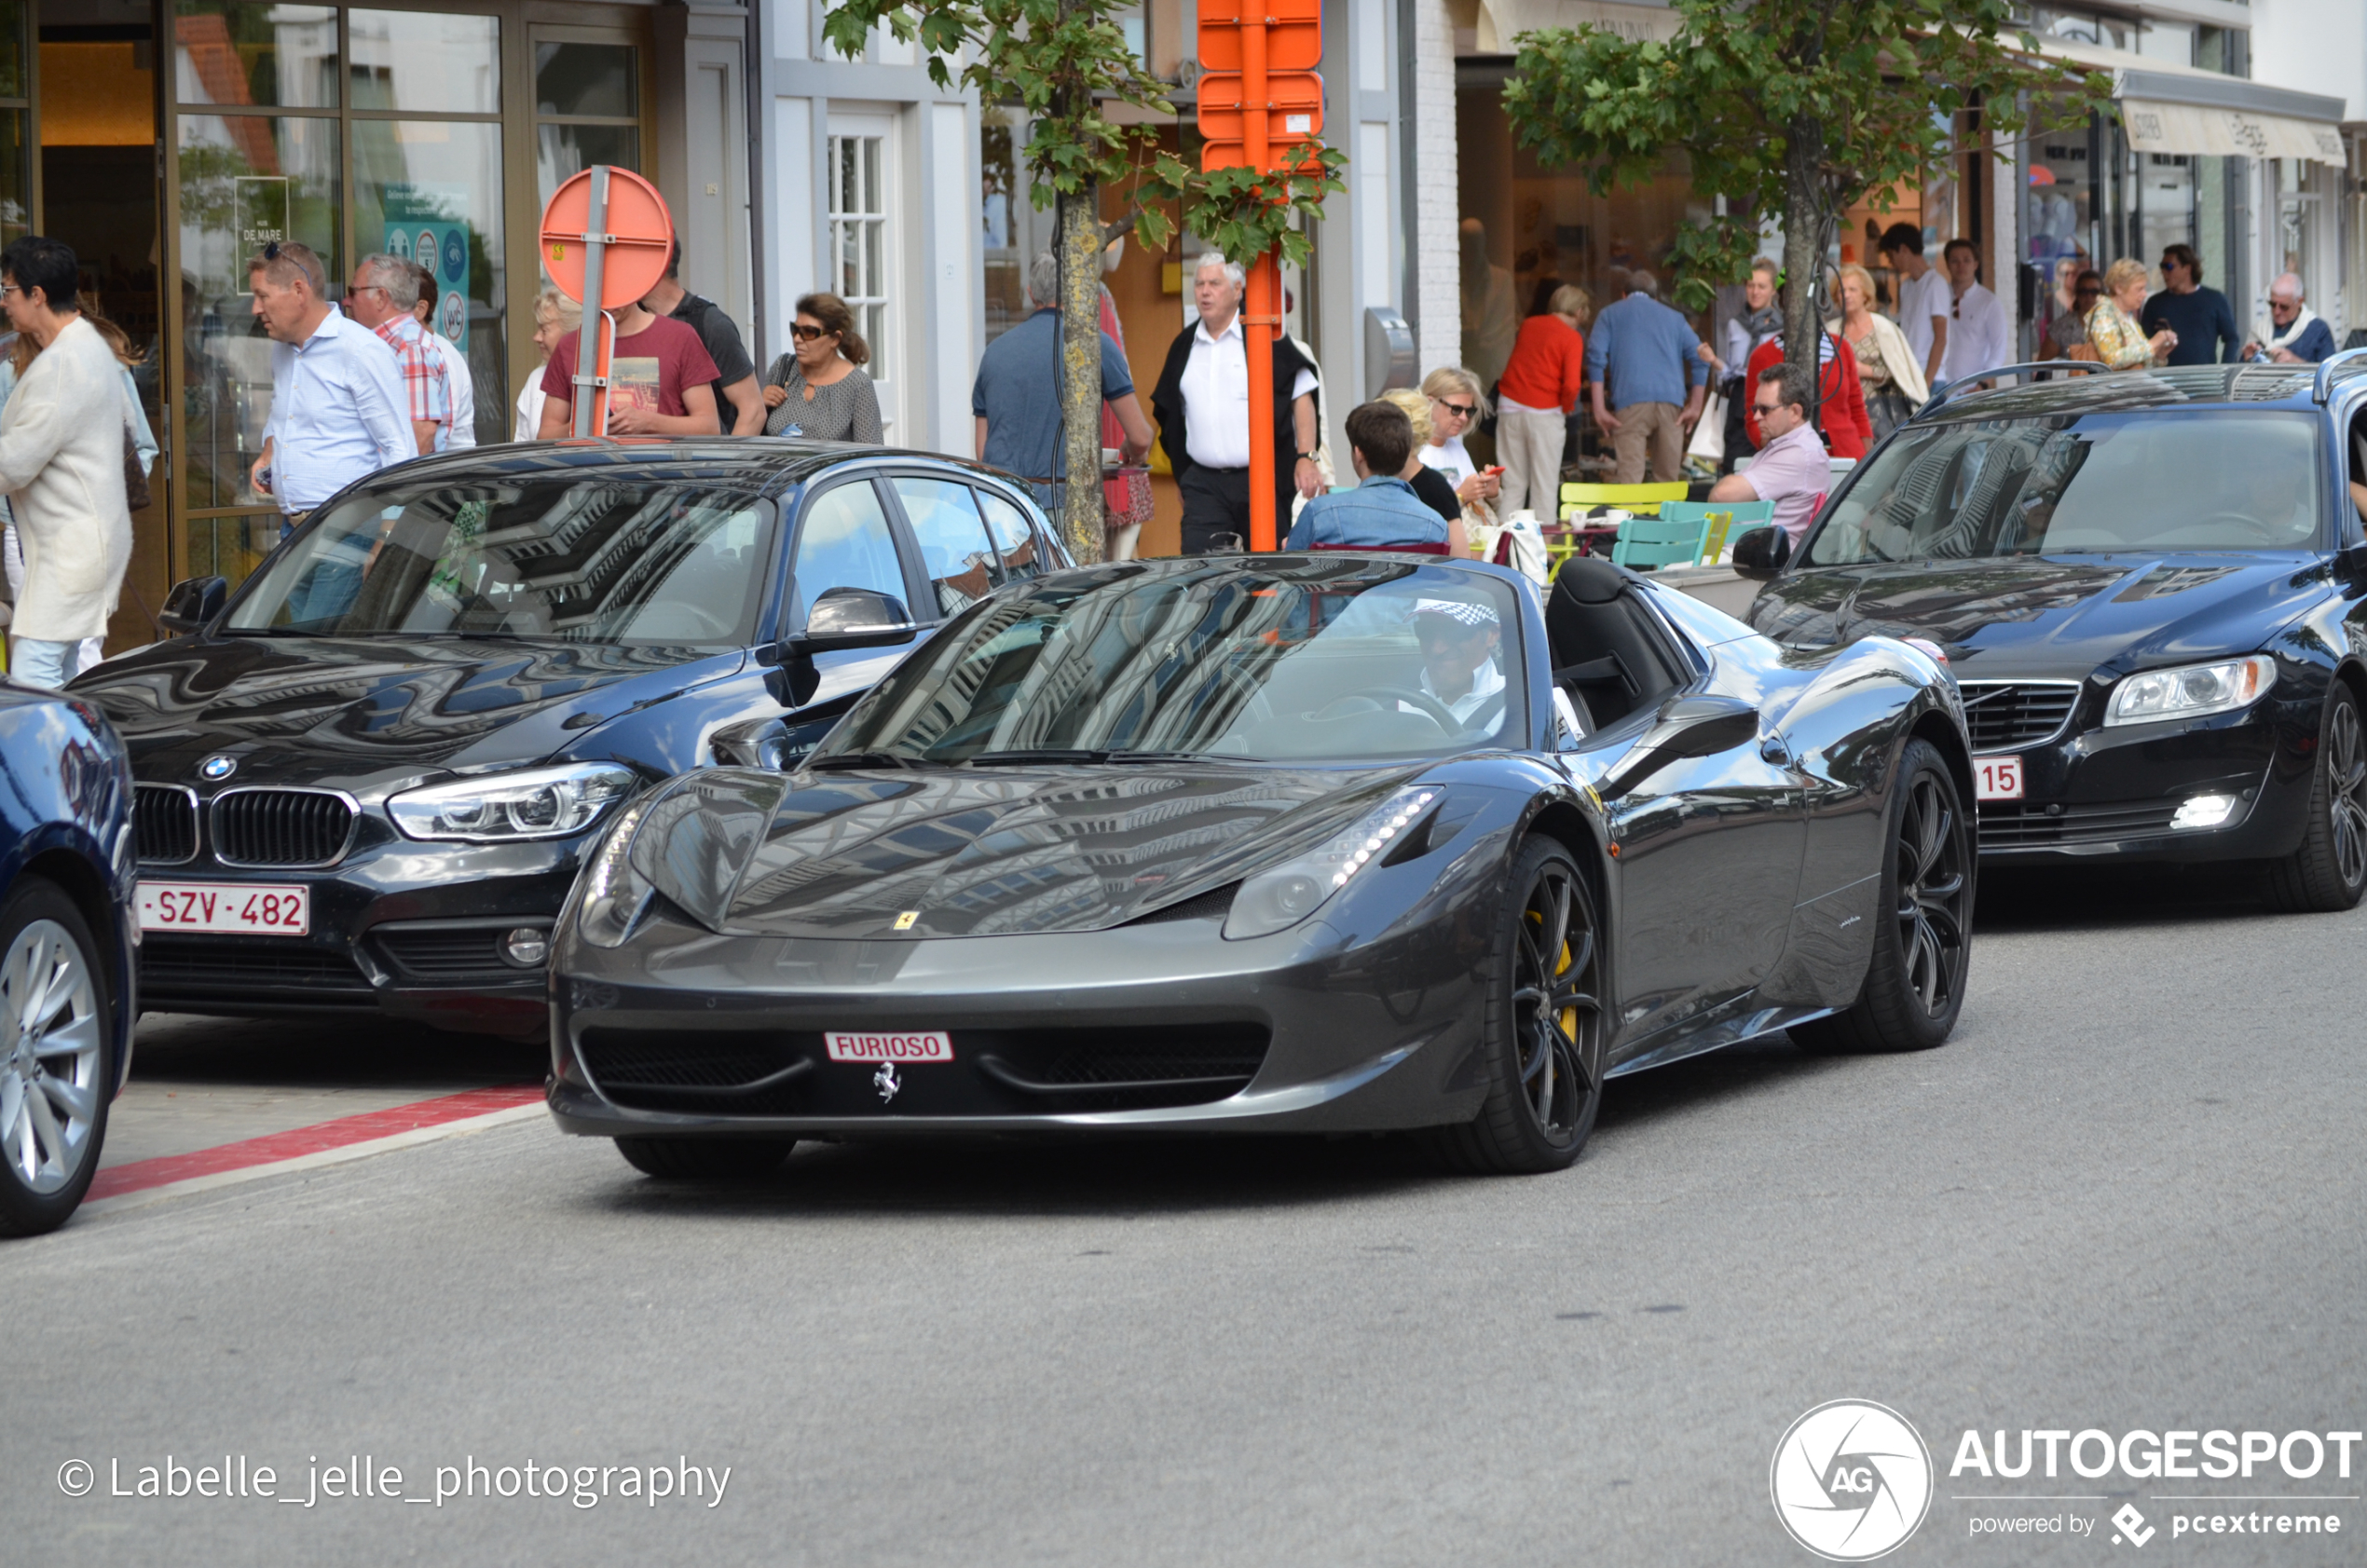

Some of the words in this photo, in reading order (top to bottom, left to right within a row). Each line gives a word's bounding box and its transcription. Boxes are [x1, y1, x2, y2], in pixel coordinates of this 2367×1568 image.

[243, 229, 256, 241] DE
[258, 229, 281, 241] MARE
[447, 309, 461, 326] WC
[835, 1036, 940, 1057] FURIOSO
